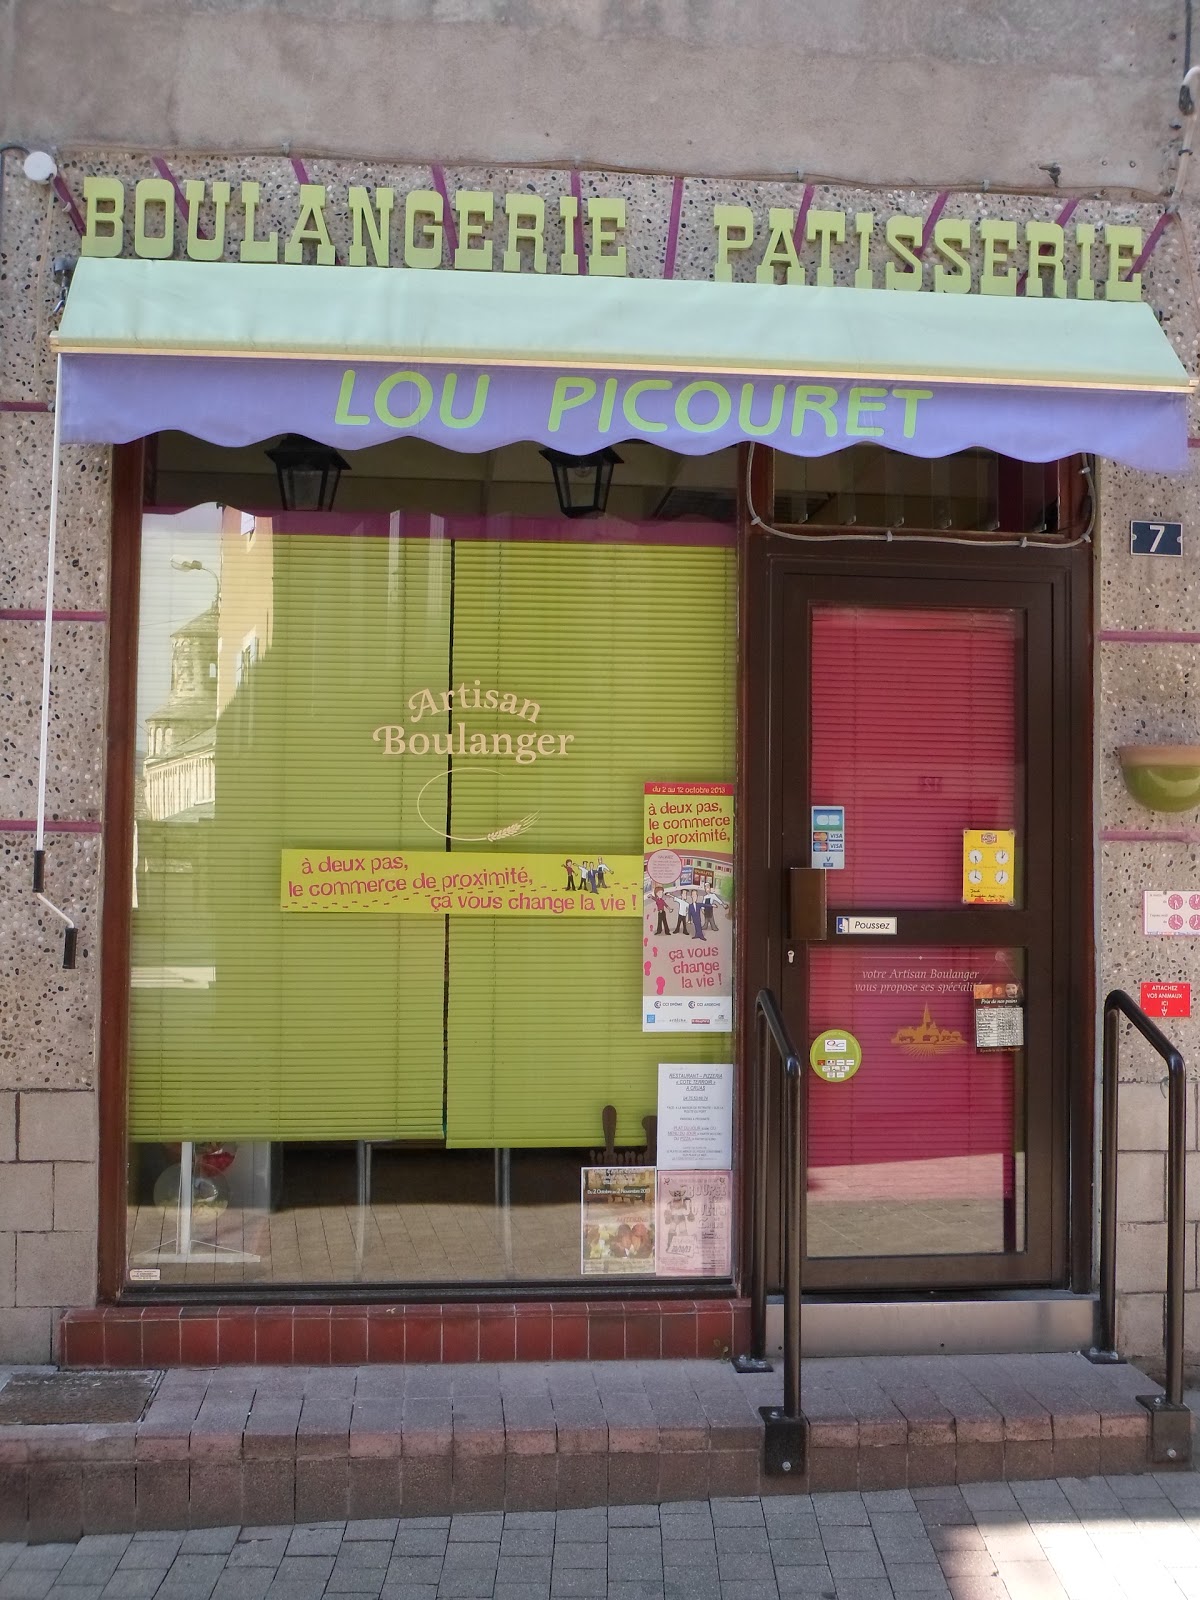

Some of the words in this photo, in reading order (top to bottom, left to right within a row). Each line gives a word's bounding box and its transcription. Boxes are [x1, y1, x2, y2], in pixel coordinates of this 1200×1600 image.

[81, 176, 627, 276] BOULANGERIE
[713, 205, 1142, 300] PATISSERIE
[334, 369, 490, 428] LOU
[547, 375, 933, 438] PICOURET
[1149, 525, 1167, 553] 7
[408, 680, 541, 724] Artisan
[372, 722, 574, 764] Boulanger
[648, 803, 657, 816] à
[660, 802, 693, 815] deux
[696, 802, 722, 816] pas,
[649, 818, 660, 830] le
[663, 816, 731, 829] commerce
[646, 833, 663, 845] de
[666, 828, 731, 847] proximité,
[301, 857, 312, 874] à
[318, 856, 366, 873] deux
[371, 855, 408, 875] pas,
[288, 881, 304, 898] le
[308, 877, 407, 897] commerce
[412, 873, 437, 890] de
[441, 867, 534, 897] proximité,
[430, 895, 452, 914] ça
[458, 895, 503, 911] vous
[508, 894, 574, 914] change
[580, 894, 595, 911] la
[600, 894, 626, 911] vie
[632, 894, 638, 911] !
[854, 920, 891, 930] Poussez
[669, 949, 685, 962] ça
[687, 946, 719, 959] vous
[673, 961, 720, 975] change
[862, 970, 887, 979] votre
[889, 968, 927, 979] Artisan
[930, 969, 980, 982] Boulanger
[681, 976, 693, 989] la
[696, 974, 715, 988] vie
[718, 973, 722, 986] !
[855, 983, 877, 992] vous
[880, 984, 918, 994] propose
[920, 984, 934, 992] ses
